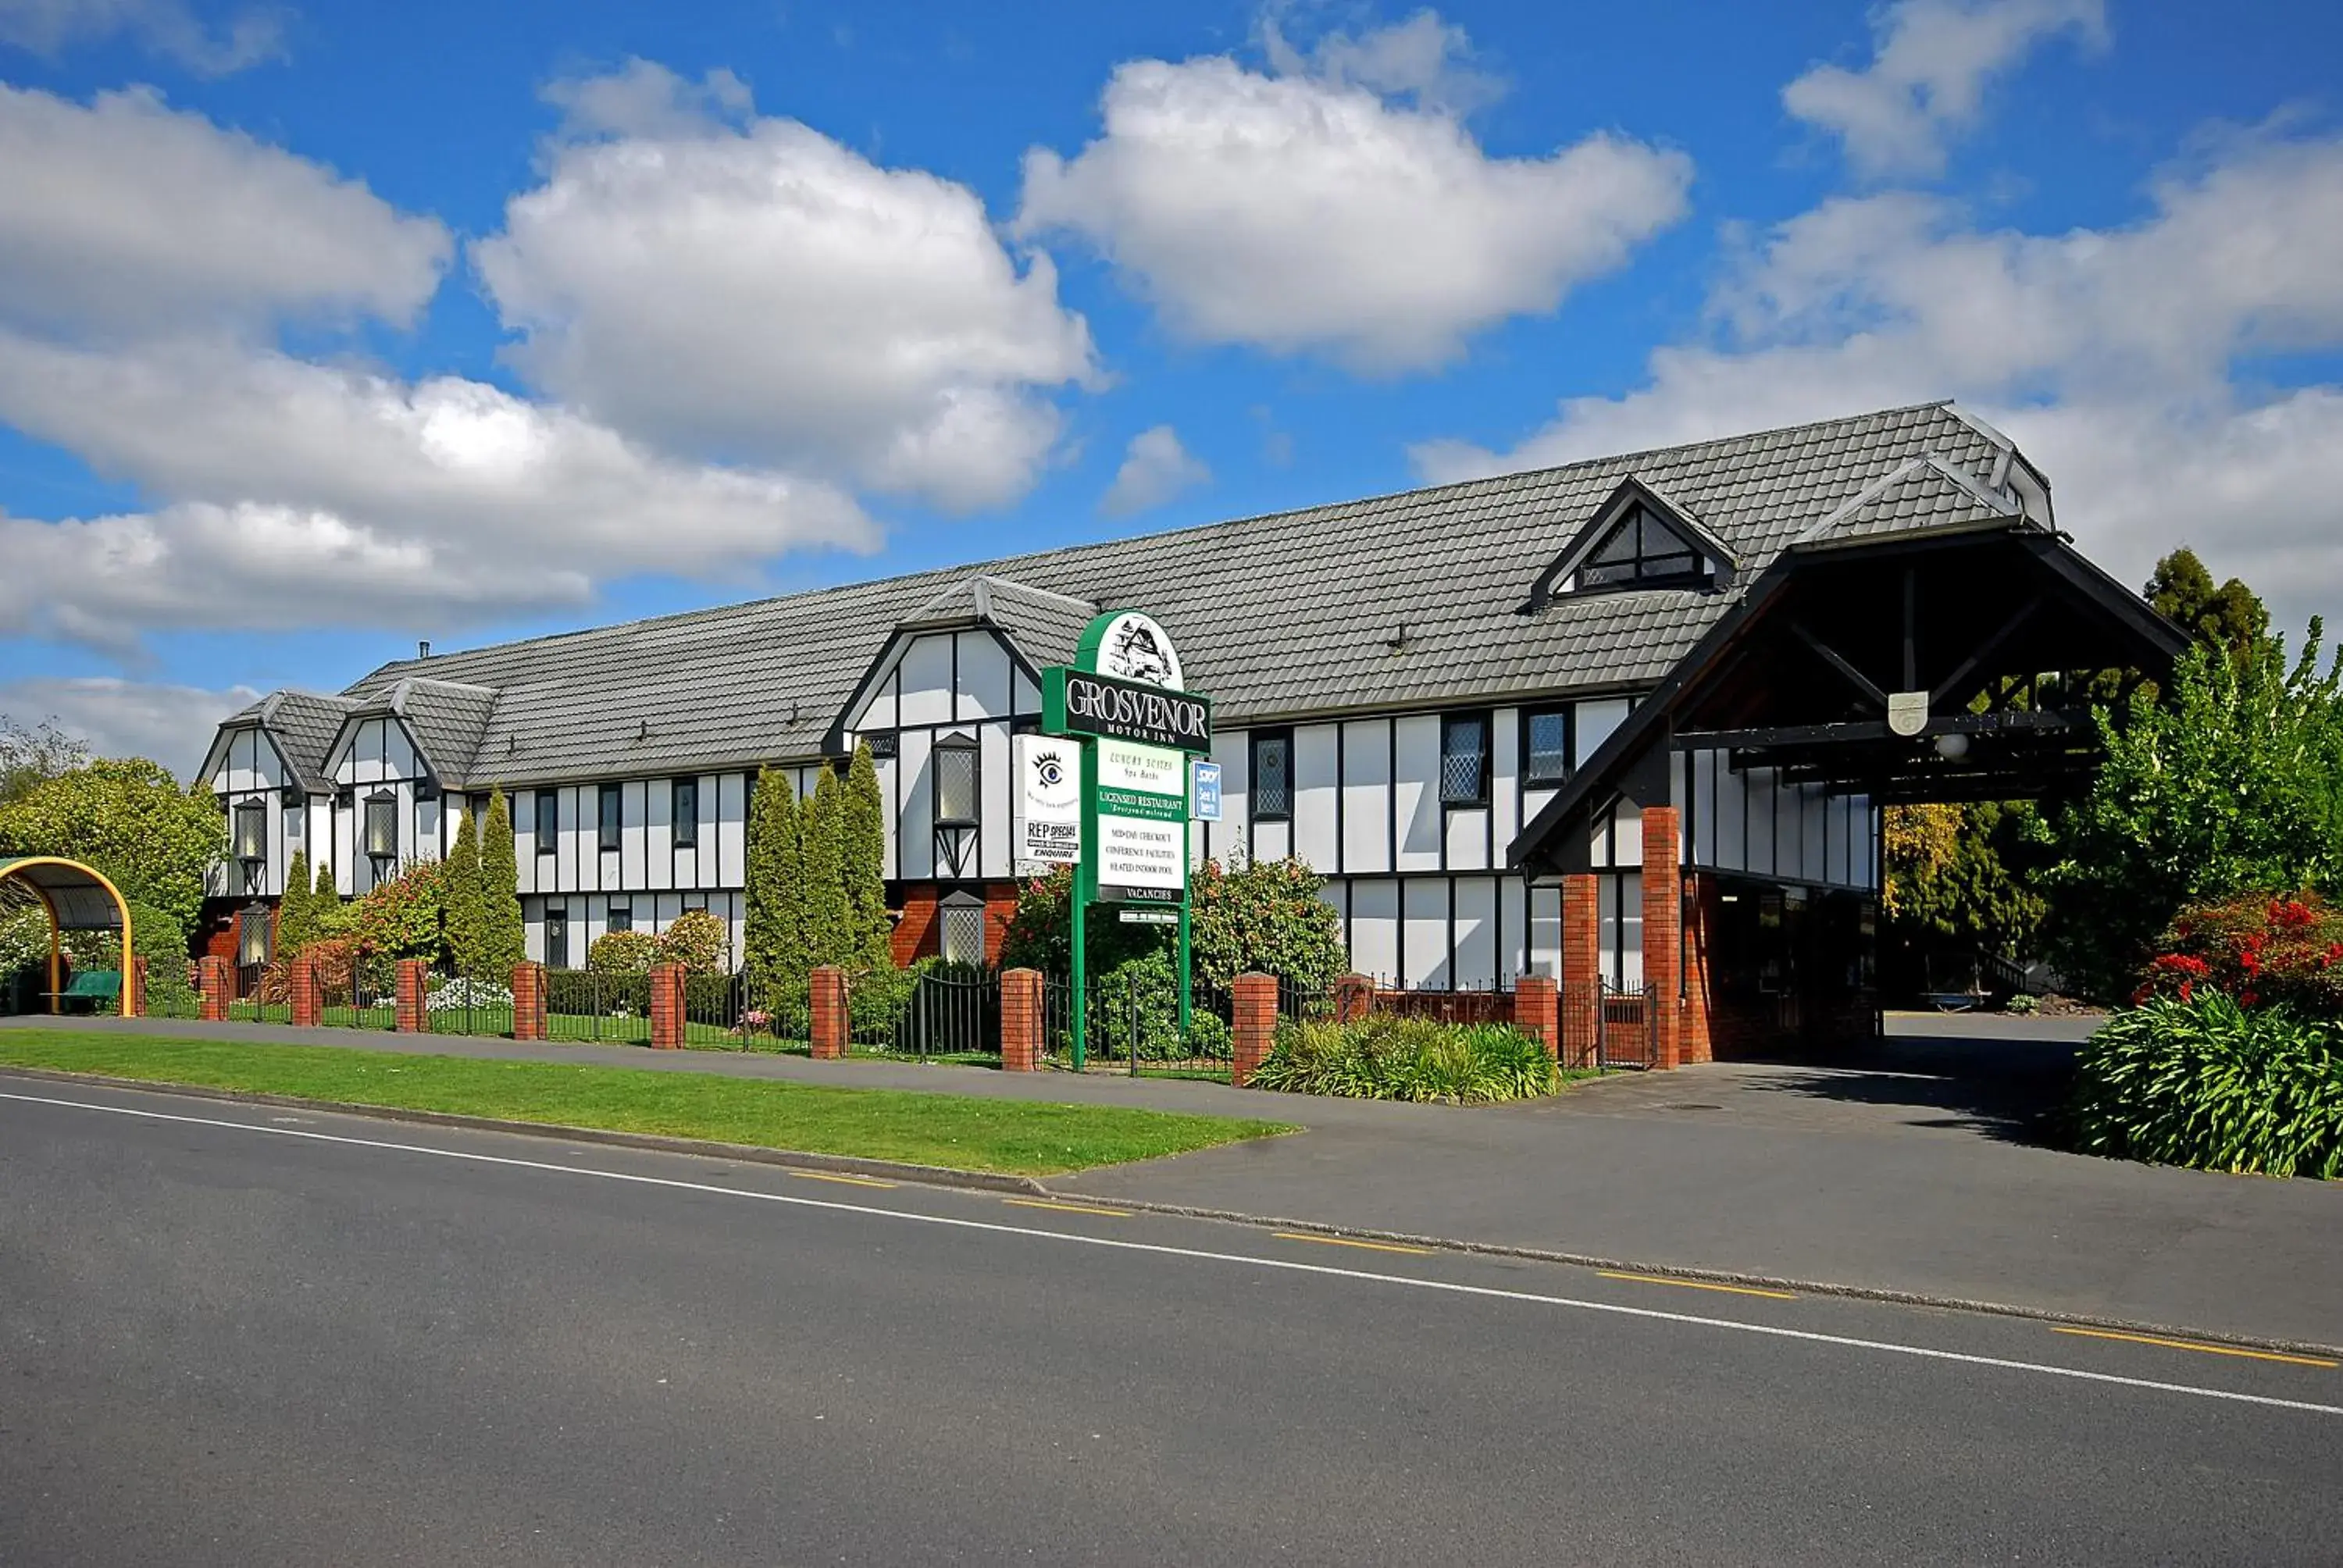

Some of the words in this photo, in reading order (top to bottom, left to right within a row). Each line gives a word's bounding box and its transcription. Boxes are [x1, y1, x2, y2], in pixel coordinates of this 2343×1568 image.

[1066, 679, 1207, 739] GROSVENOR
[1107, 724, 1148, 739] MOTOR
[1154, 731, 1175, 744] INN
[1138, 796, 1182, 811] RESTAURANT
[1028, 822, 1050, 838] REP
[1034, 849, 1075, 858] ENQUIRE
[1105, 846, 1143, 857] CONFERENCE
[1126, 888, 1172, 900] VACANCIES
